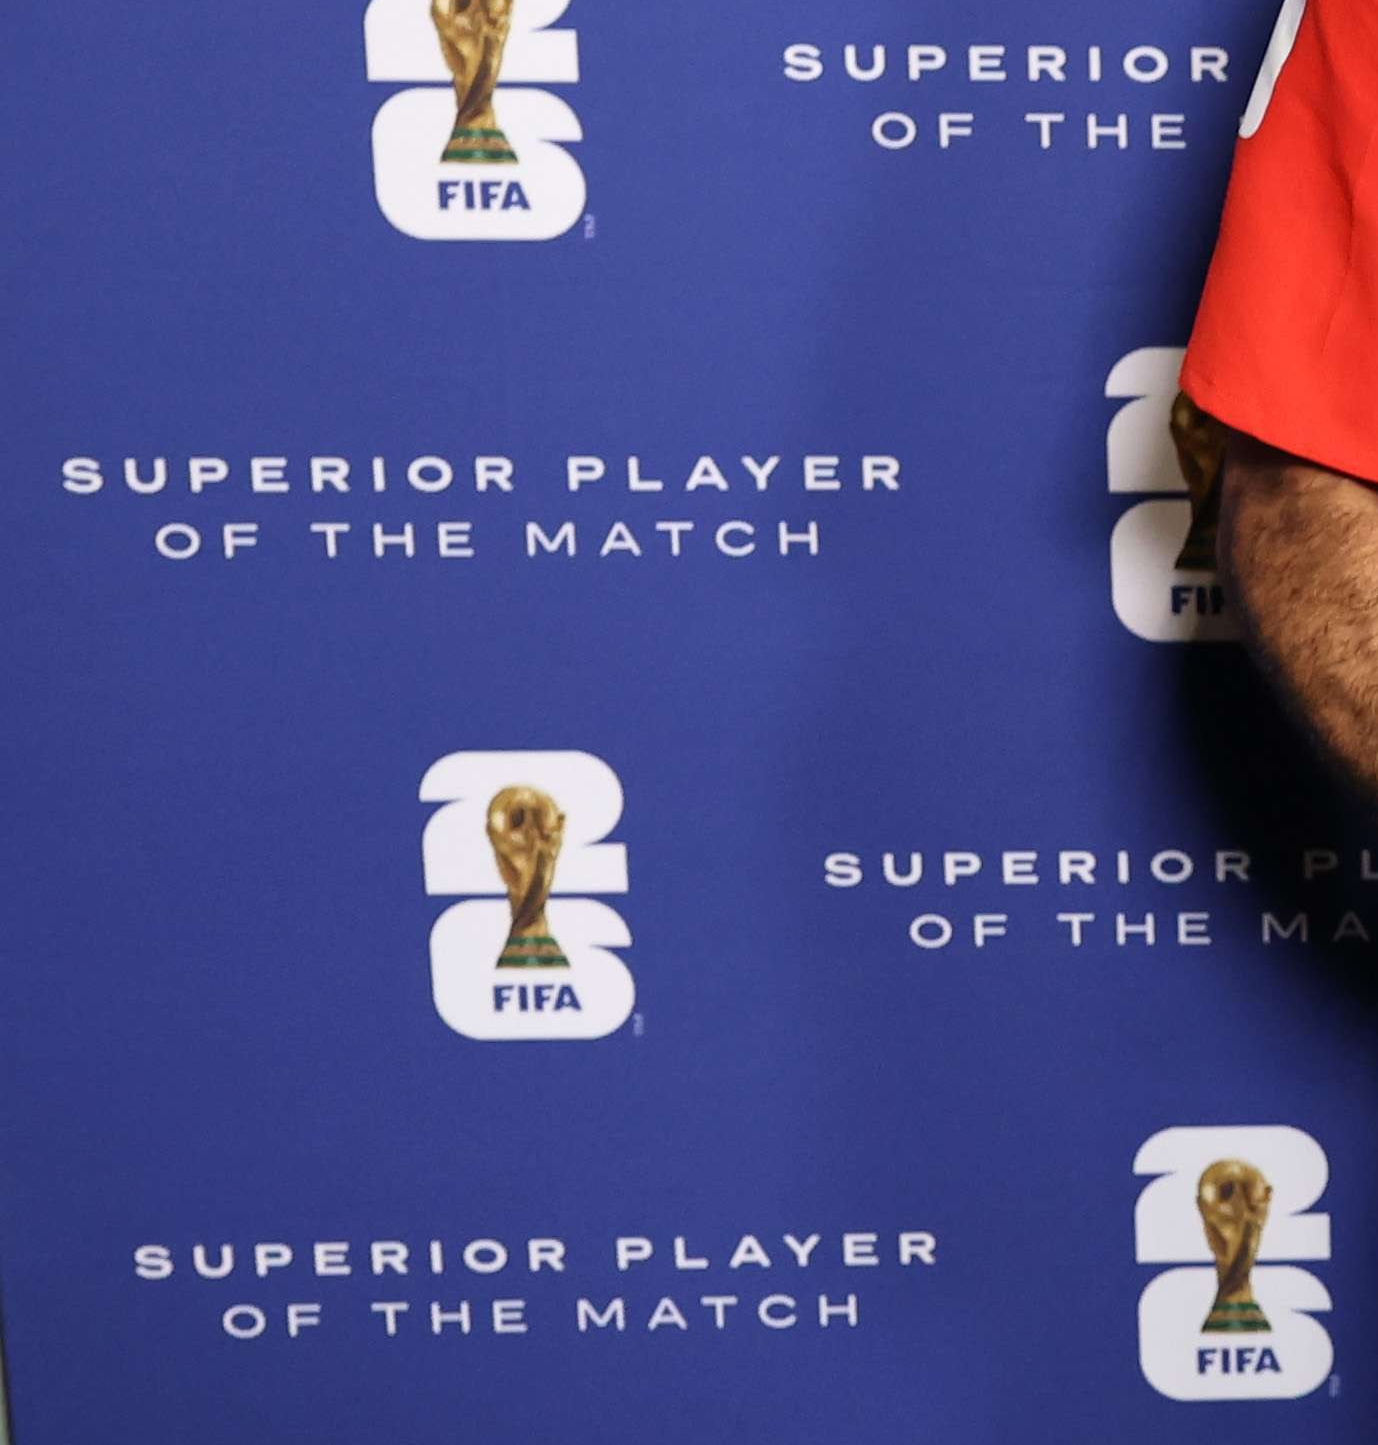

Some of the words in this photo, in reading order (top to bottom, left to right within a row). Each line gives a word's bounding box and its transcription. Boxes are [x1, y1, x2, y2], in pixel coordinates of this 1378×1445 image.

[784, 44, 1228, 82] SUPERIOR
[873, 112, 973, 148] OF
[1026, 113, 1185, 148] THE
[437, 180, 531, 211] FIFA
[63, 457, 512, 493] SUPERIOR
[568, 456, 899, 491] PLAYER
[156, 524, 257, 558] OF
[311, 523, 473, 557] THE
[527, 521, 817, 556] MATCH
[825, 850, 1251, 886] SUPERIOR
[910, 914, 1007, 948] OF
[1057, 913, 1211, 946] THE
[492, 984, 582, 1013] FIFA
[135, 1239, 564, 1279] SUPERIOR
[617, 1233, 935, 1270] PLAYER
[223, 1304, 320, 1338] OF
[371, 1300, 527, 1334] THE
[578, 1295, 857, 1331] MATCH
[1196, 1346, 1283, 1376] FIFA
